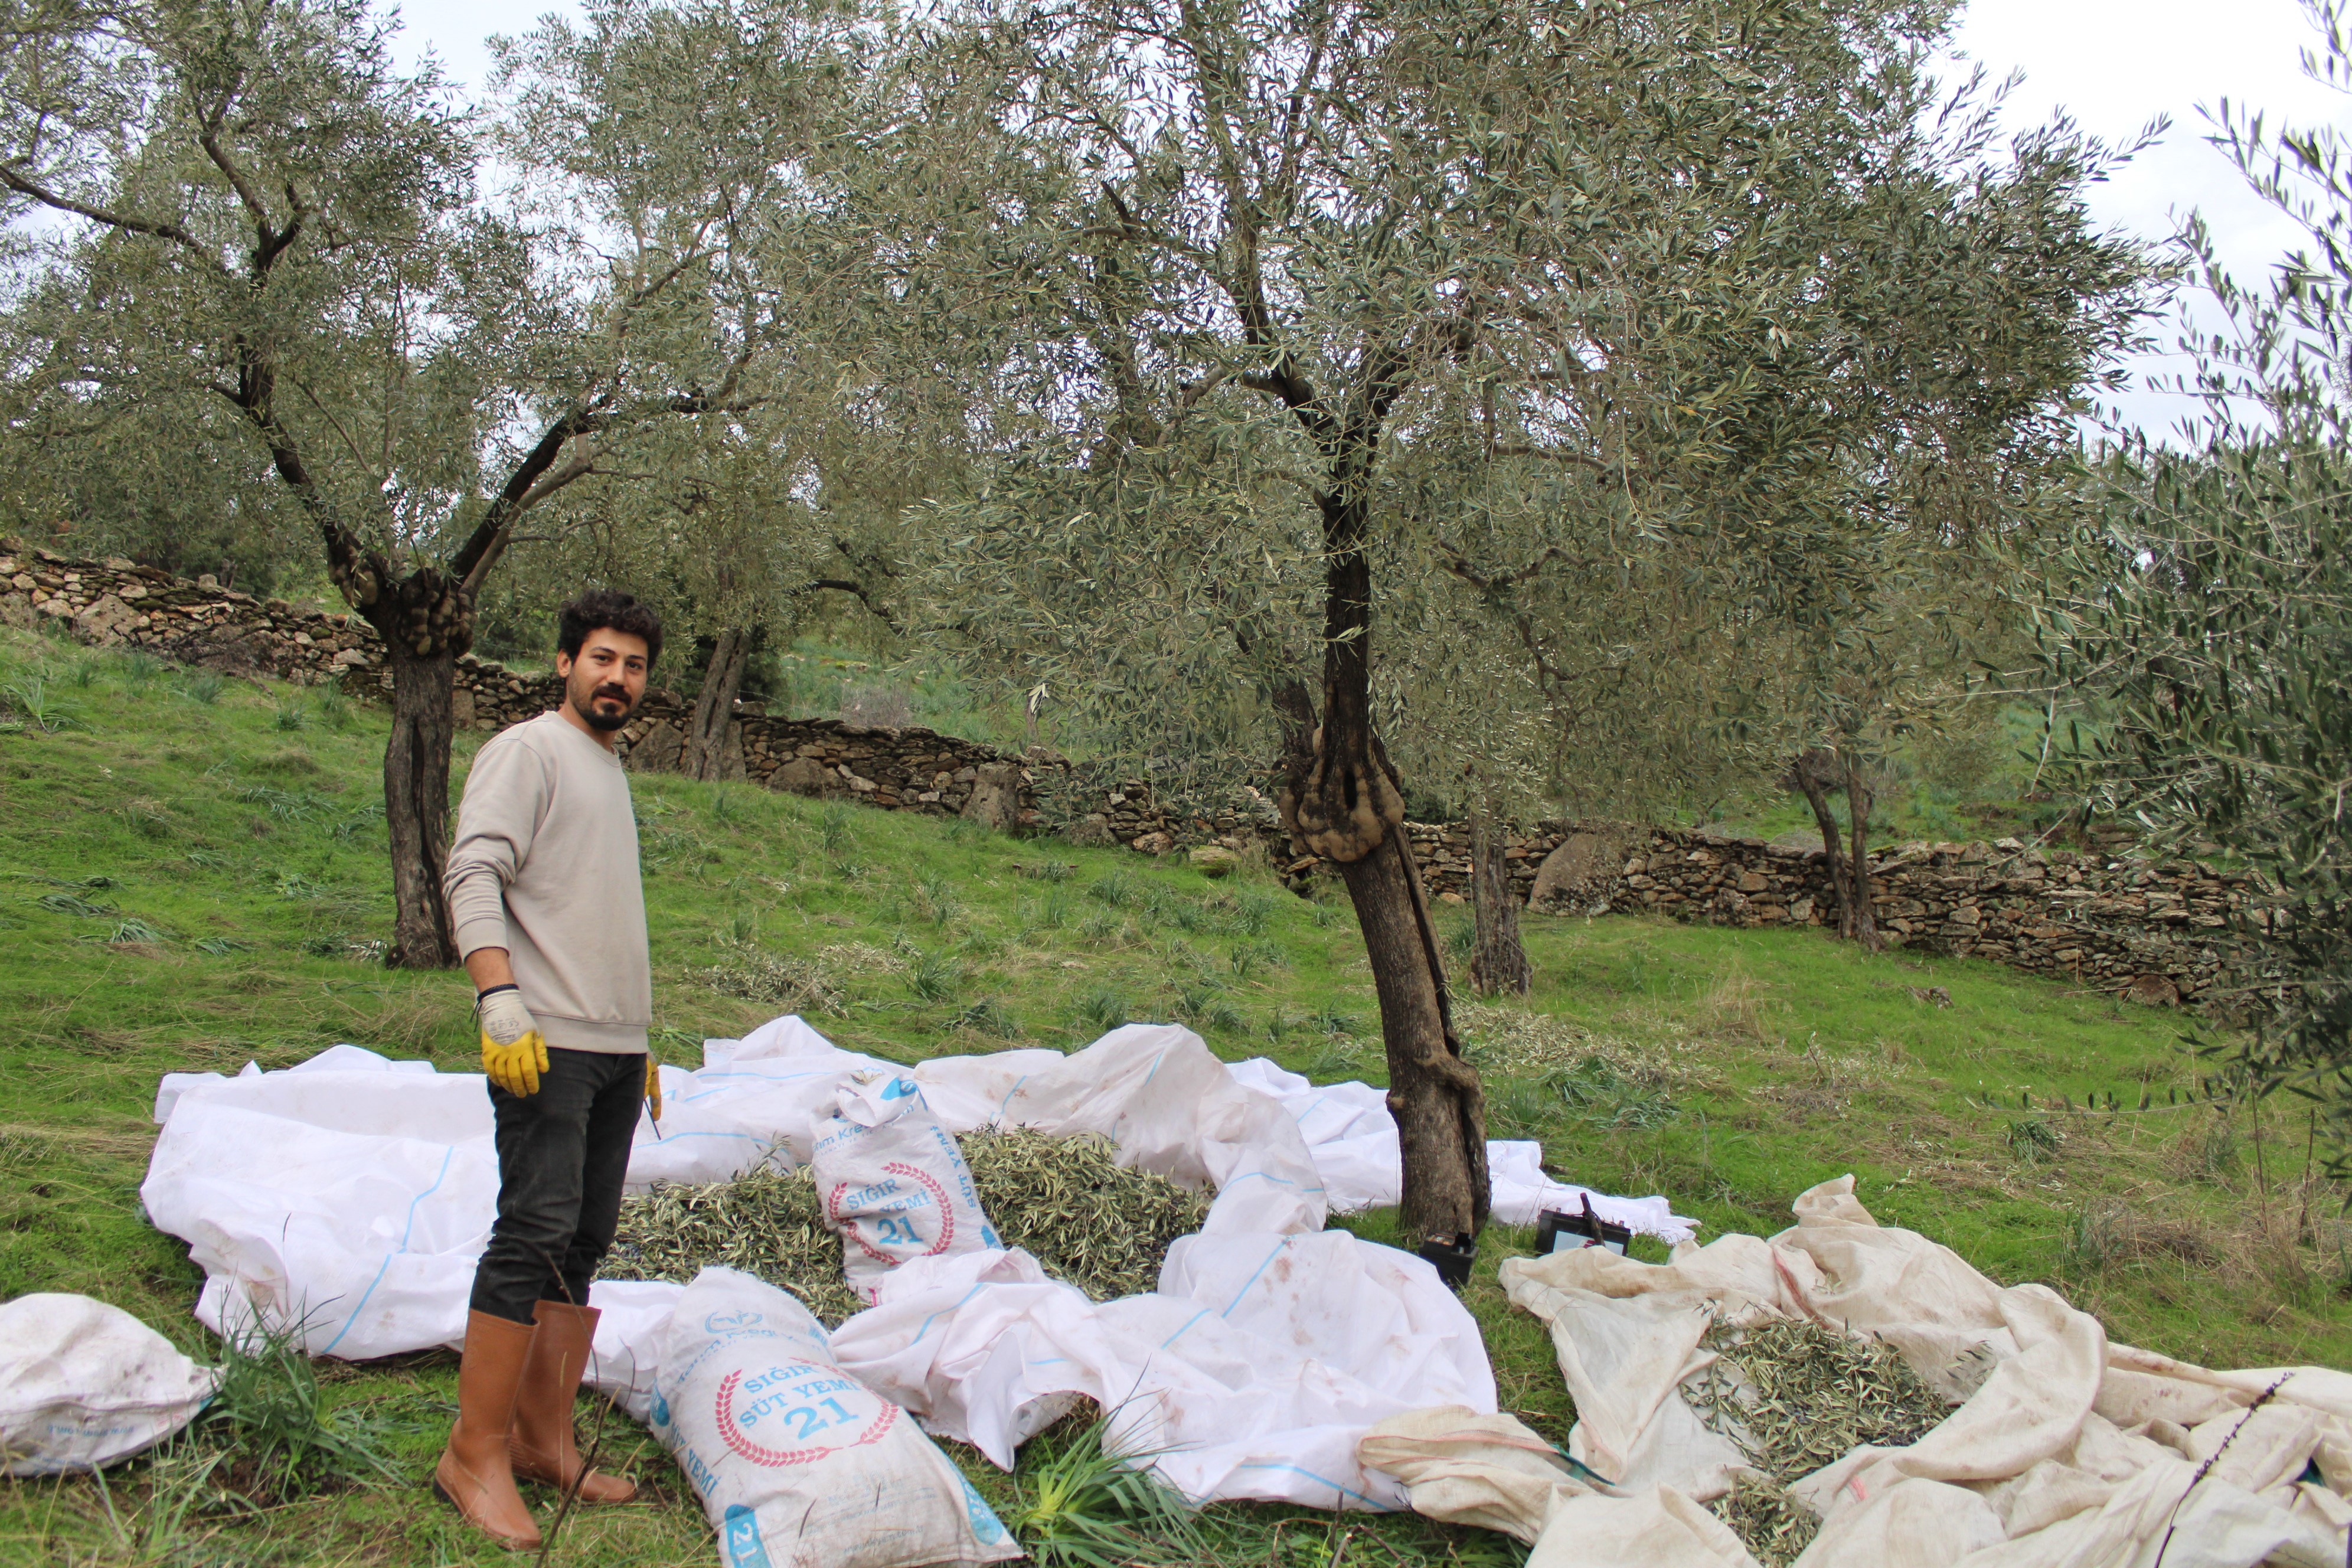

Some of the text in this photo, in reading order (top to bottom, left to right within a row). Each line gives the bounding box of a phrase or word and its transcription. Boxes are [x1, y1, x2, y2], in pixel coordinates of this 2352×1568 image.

[847, 1179, 901, 1210] SIĞIR
[959, 1174, 976, 1208] SÜT
[877, 1216, 924, 1244] 21
[744, 1364, 820, 1394] SIĞIR
[739, 1391, 787, 1429] SÜT
[783, 1397, 860, 1440] 21
[687, 1448, 721, 1498] YEMİ
